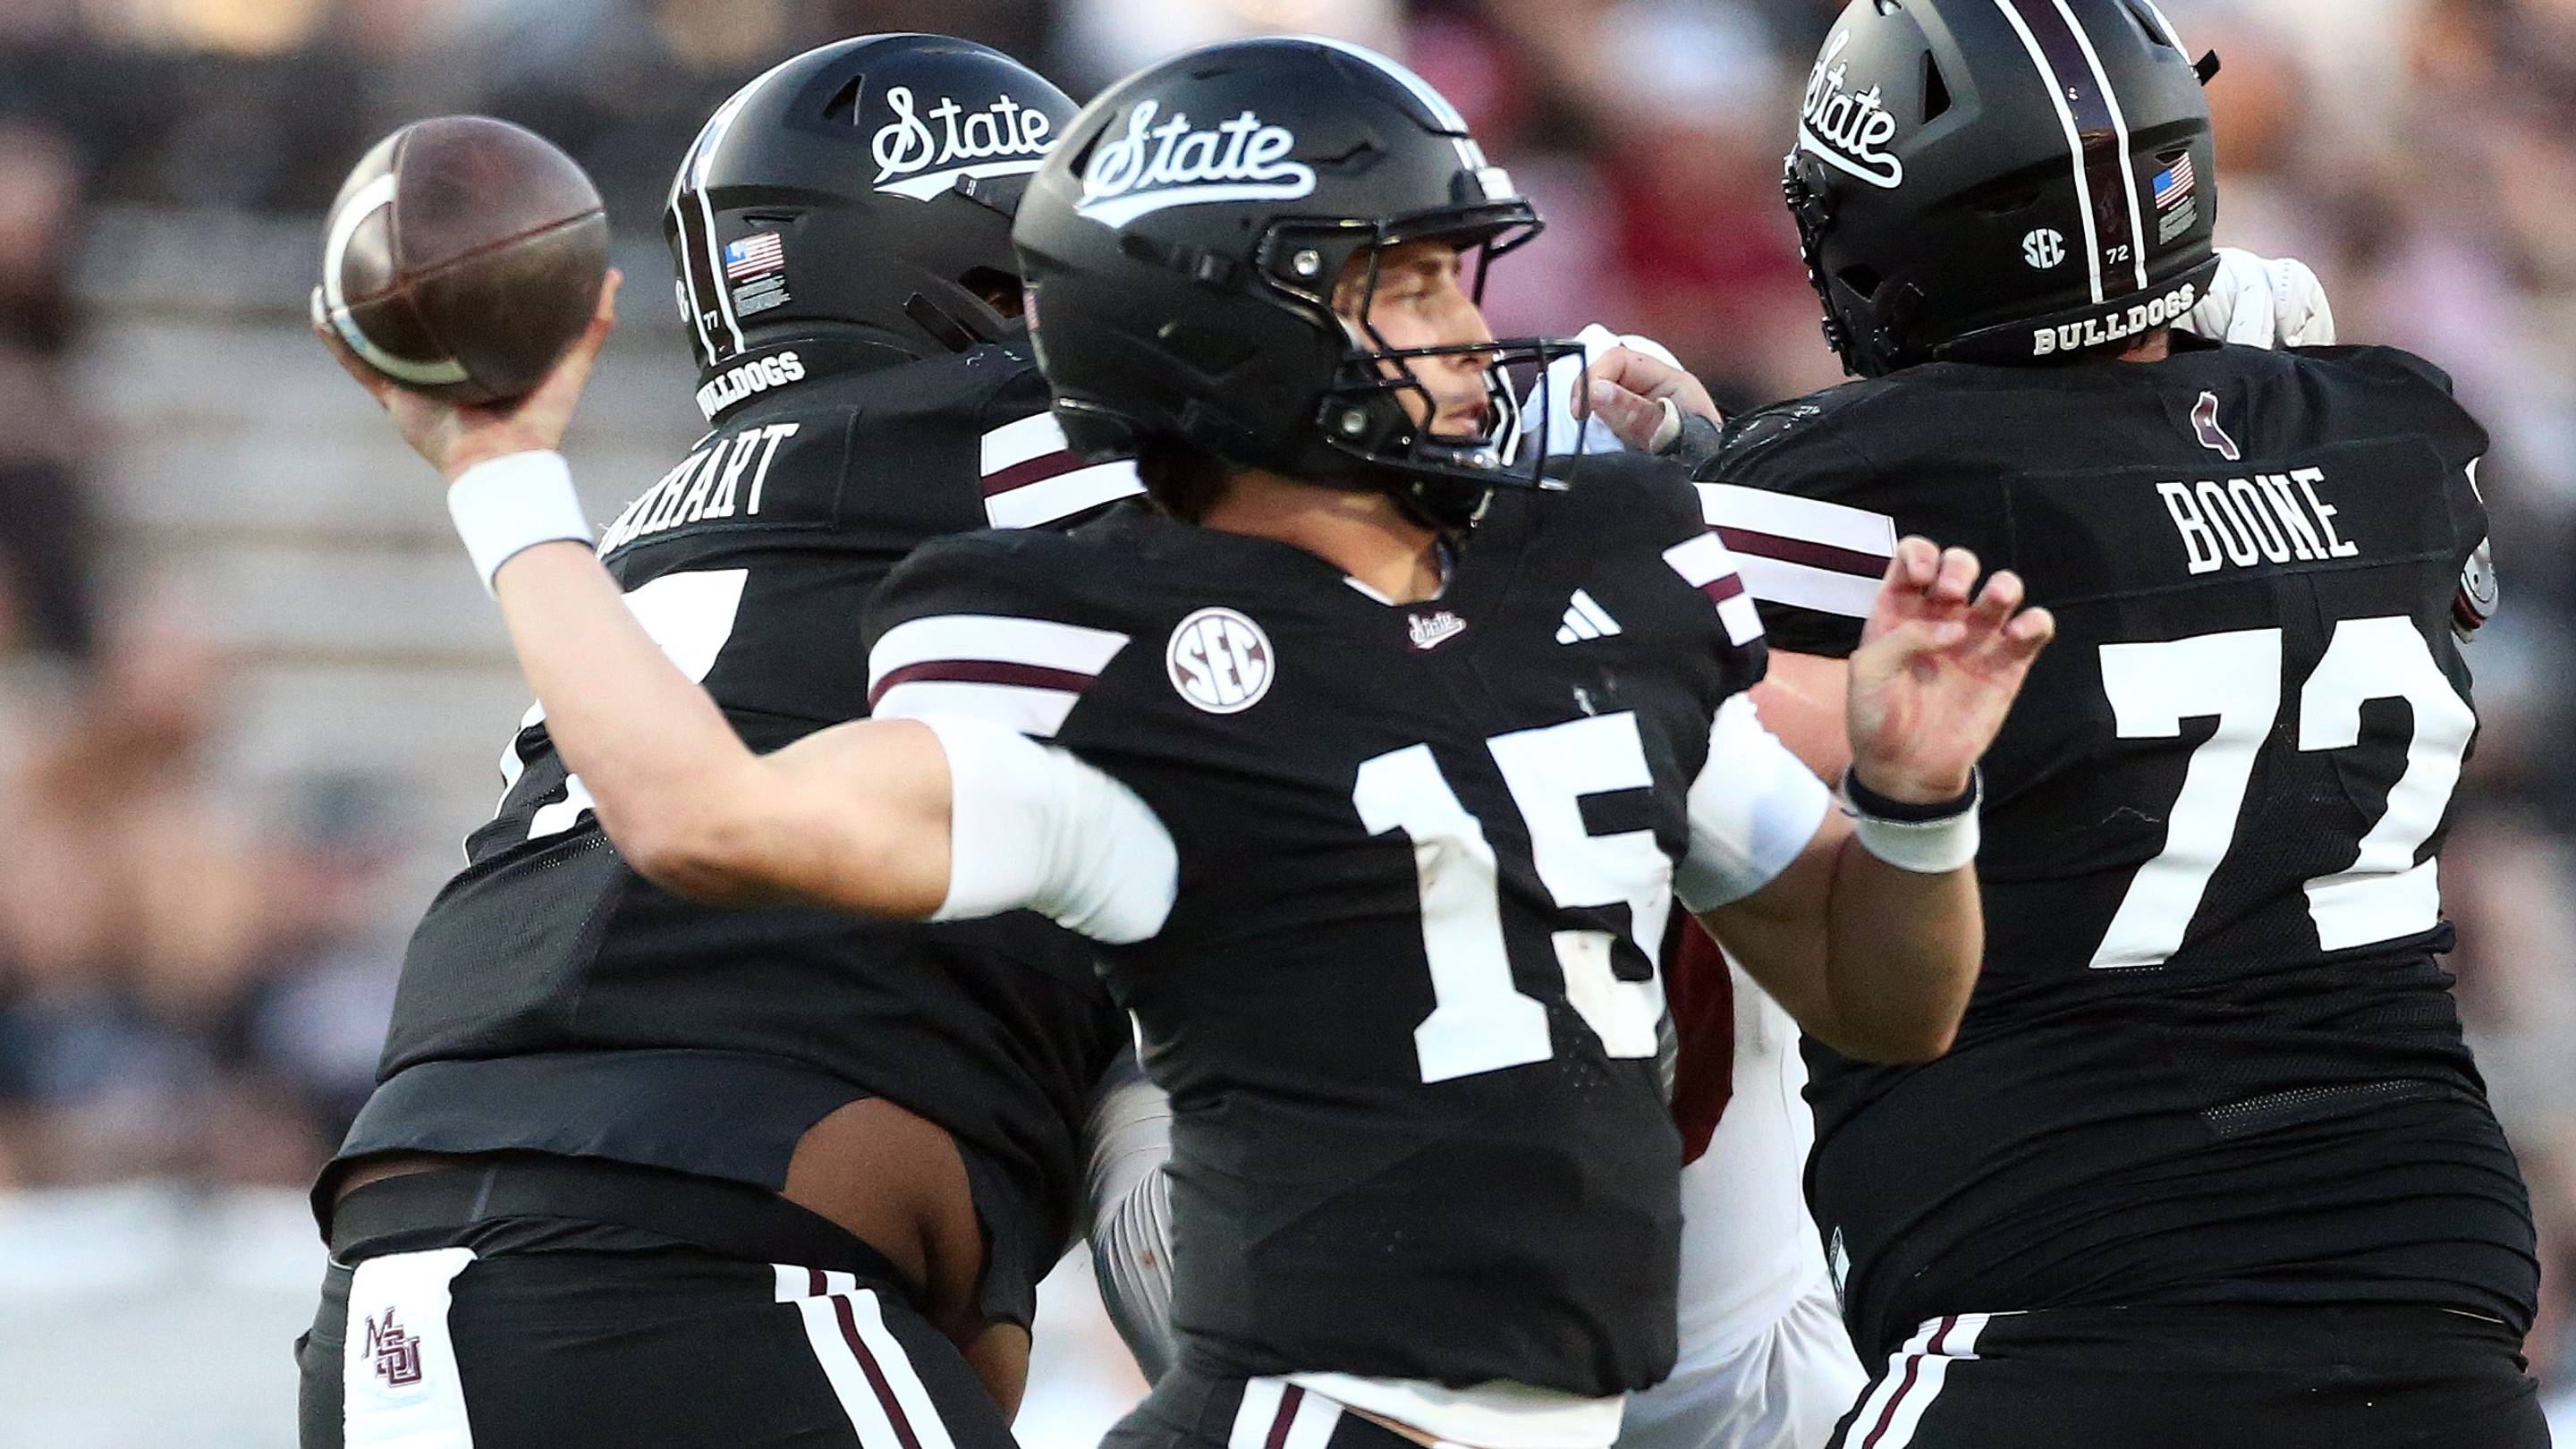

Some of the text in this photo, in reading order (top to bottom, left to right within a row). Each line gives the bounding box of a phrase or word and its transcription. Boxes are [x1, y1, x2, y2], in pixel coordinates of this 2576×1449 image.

[870, 86, 1061, 203] State
[1075, 98, 1318, 229] State
[1798, 28, 1903, 189] State
[2021, 227, 2066, 269] SEC
[2106, 244, 2130, 266] 72
[2032, 282, 2197, 357] BULLDOGS
[2156, 466, 2360, 576] BOONE
[1172, 614, 1268, 708] SEC
[2088, 614, 2477, 970] 72
[1352, 710, 1674, 1084] 15
[360, 1305, 423, 1387] MSU
